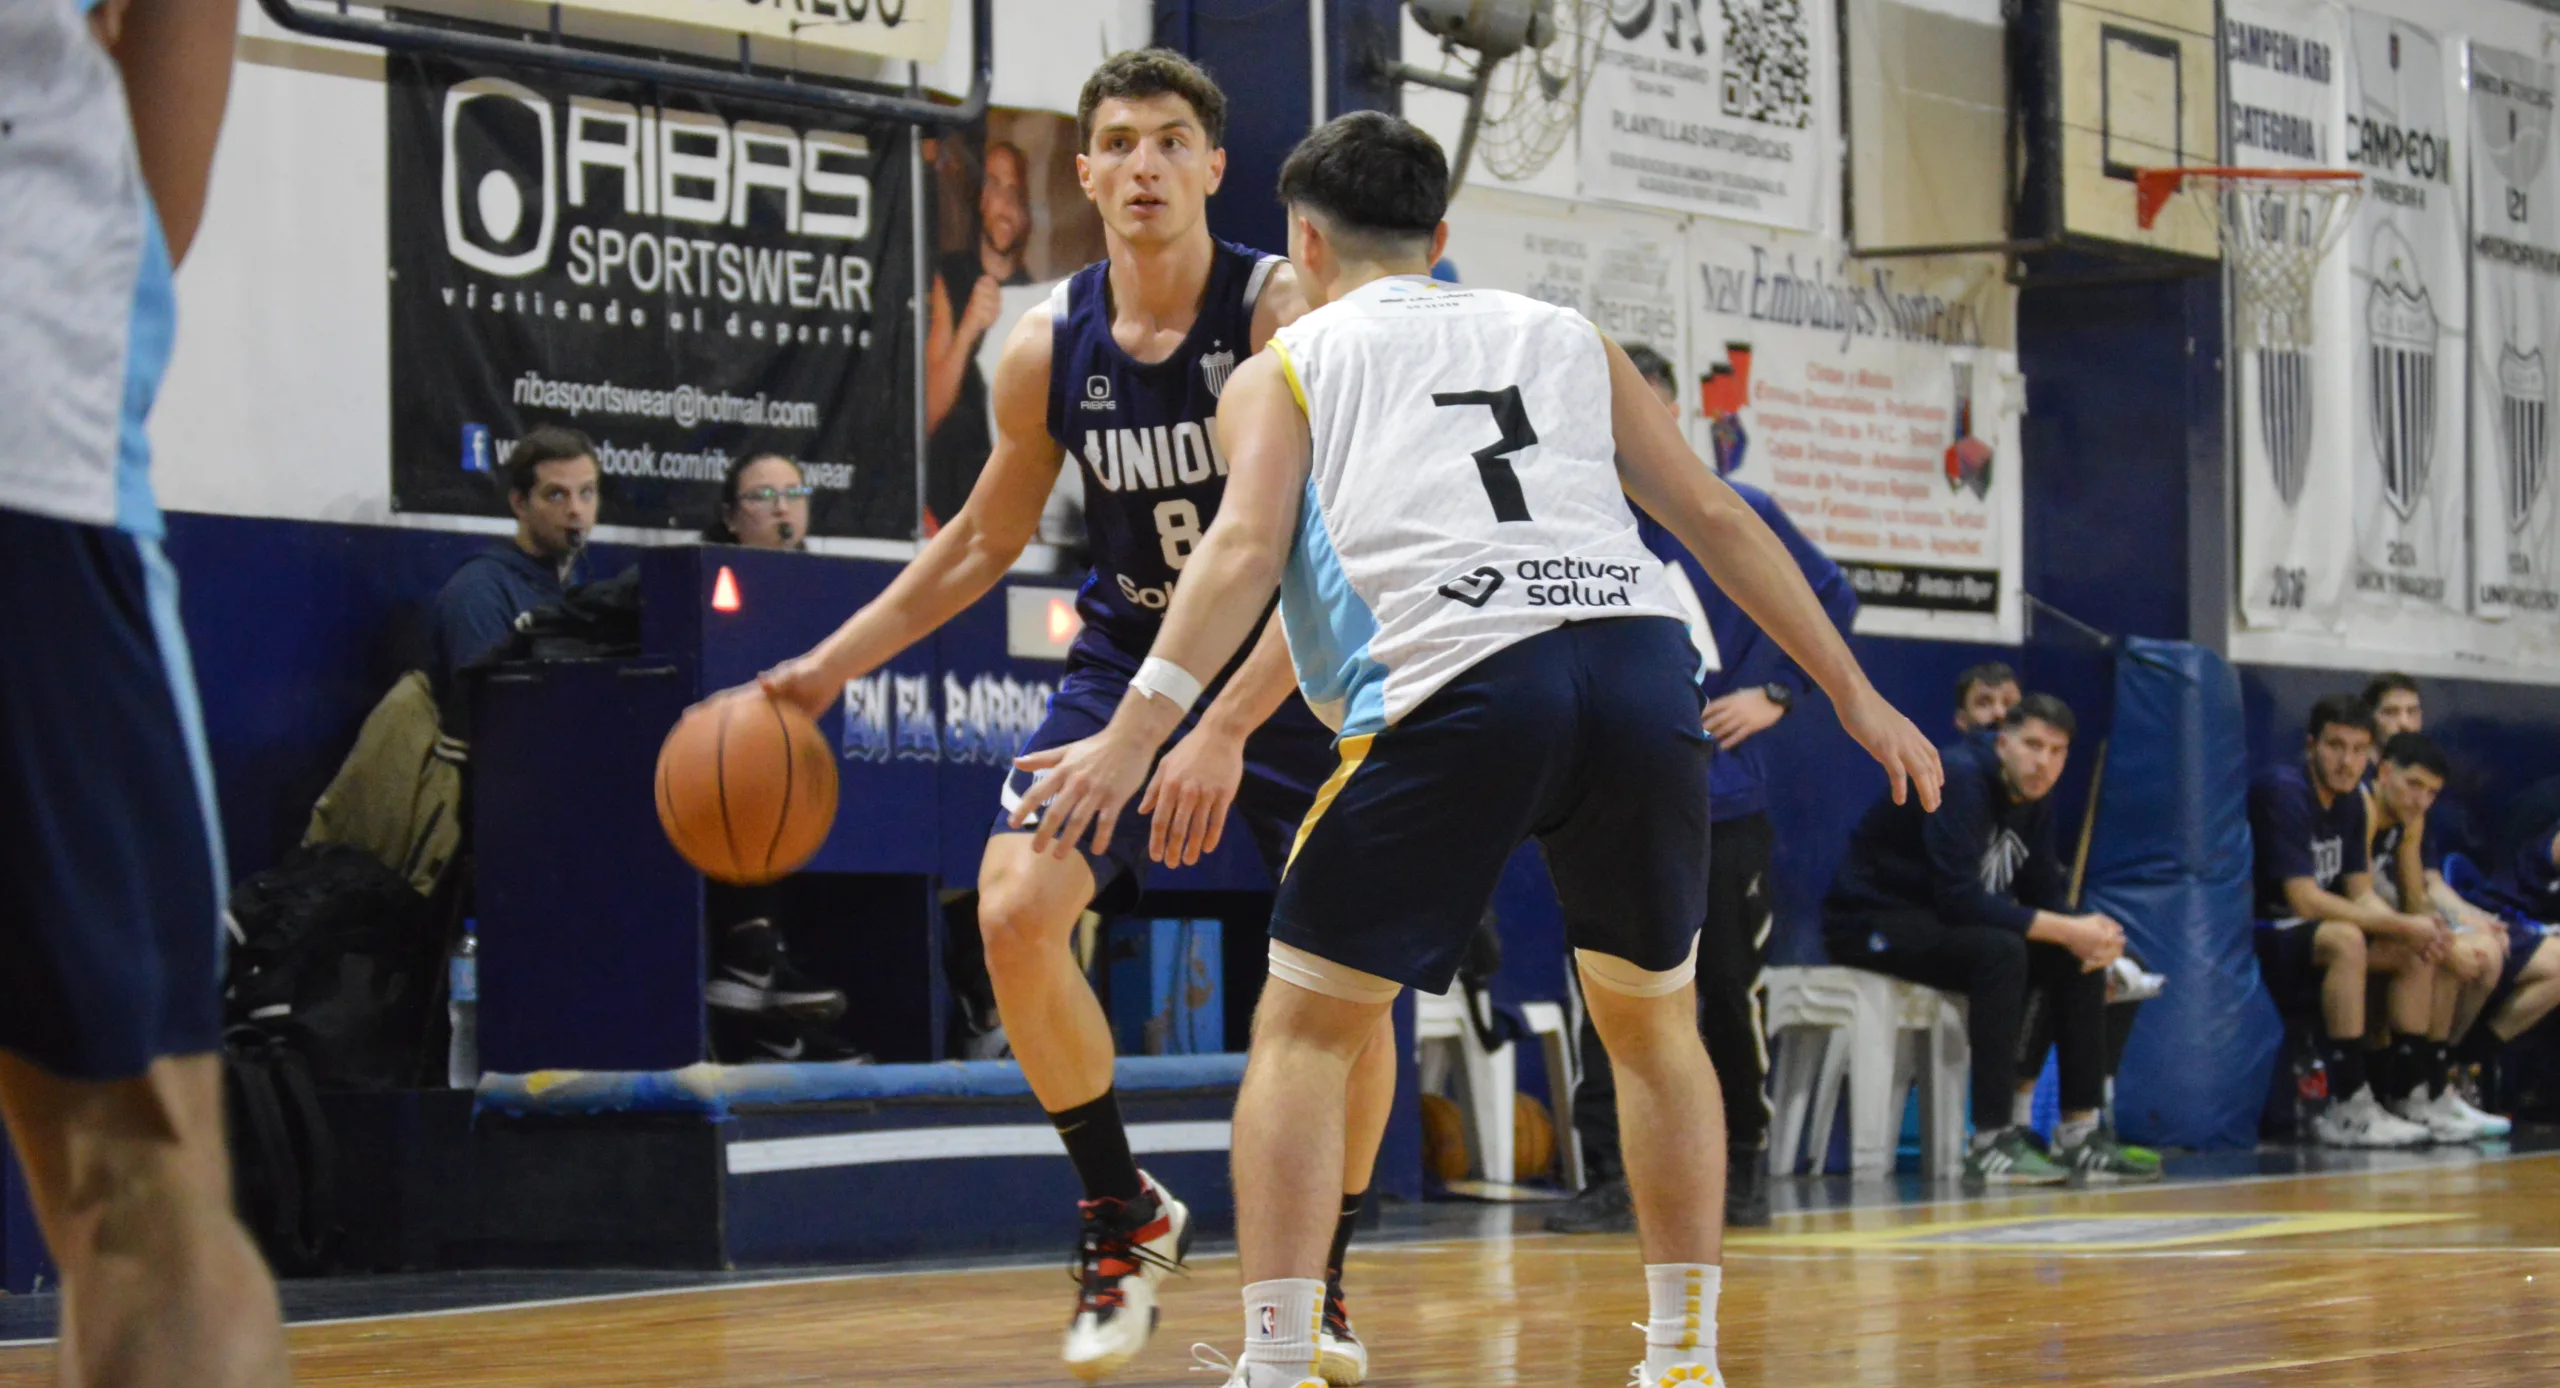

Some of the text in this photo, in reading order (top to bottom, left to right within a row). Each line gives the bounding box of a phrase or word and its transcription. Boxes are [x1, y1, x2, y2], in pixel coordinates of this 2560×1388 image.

[1612, 109, 1698, 147] PLANTILLAS
[2347, 113, 2450, 186] CAMPEON
[566, 94, 871, 240] RIBAS
[566, 224, 872, 313] SPORTSWEAR
[442, 283, 873, 348] vistiendo al deporte
[513, 371, 818, 428] ribasportswear@hotmail.com
[1080, 400, 1117, 410] RIBAS
[1431, 384, 1539, 523] 7
[1153, 499, 1204, 571] 8
[1517, 556, 1641, 584] activar
[1527, 581, 1631, 607] salud
[843, 669, 892, 764] EN
[894, 671, 941, 762] EL
